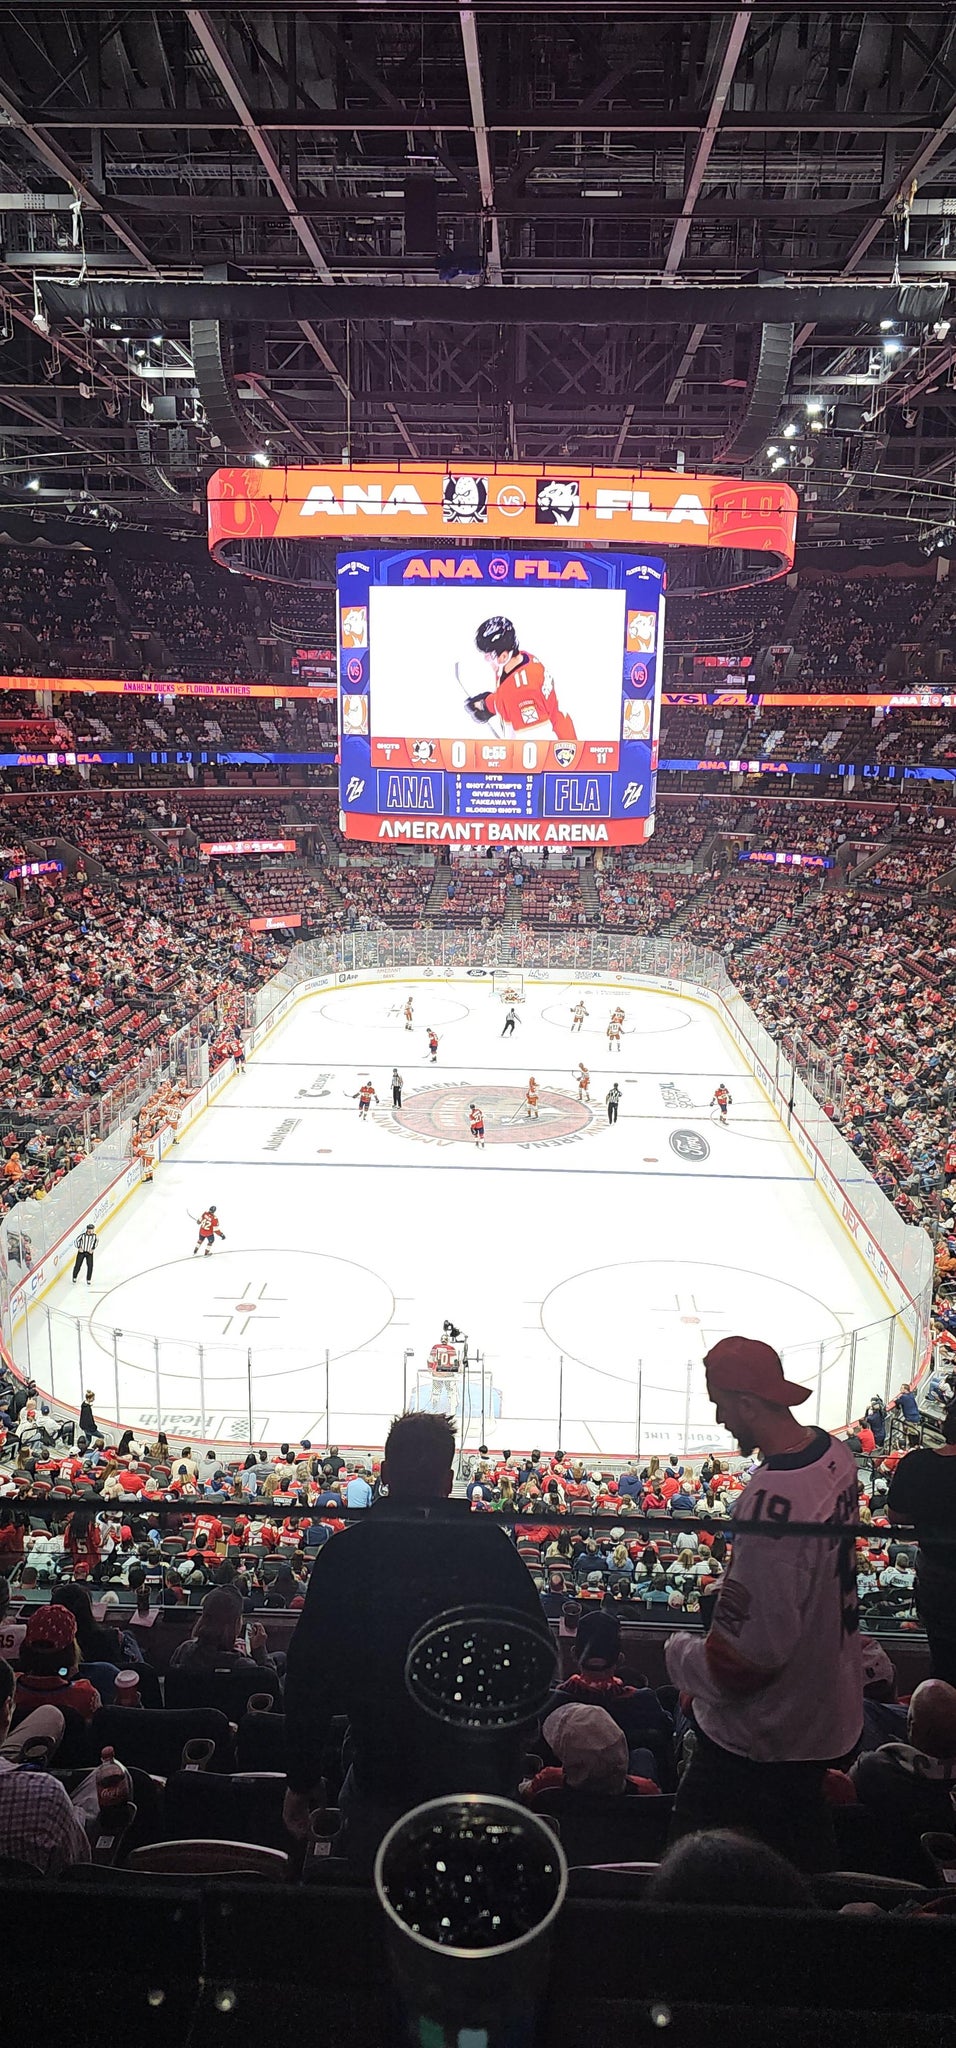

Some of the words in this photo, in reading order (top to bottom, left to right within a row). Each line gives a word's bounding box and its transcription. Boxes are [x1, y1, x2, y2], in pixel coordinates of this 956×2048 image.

[299, 484, 428, 515] ANA
[503, 495, 520, 504] VS
[596, 489, 709, 525] FLA
[402, 558, 483, 578] ANA
[514, 560, 589, 580] FLA
[350, 665, 360, 676] VS
[635, 670, 645, 681] VS
[514, 669, 528, 688] 11
[124, 683, 152, 691] ANAHEIM
[154, 683, 175, 692] DUCKS
[186, 685, 214, 694] FLORIDA
[216, 687, 251, 695] PANTHERS
[666, 695, 699, 703] VS
[17, 754, 46, 764] ANA
[76, 753, 102, 763] FLA
[452, 740, 466, 768] 0
[523, 741, 537, 769] 0
[597, 753, 607, 764] 11
[697, 761, 727, 770] ANA
[761, 762, 788, 772] FLA
[387, 775, 434, 809] ANA
[555, 778, 600, 811] FLA
[378, 820, 484, 841] AMERANT
[488, 823, 540, 842] BANK
[544, 823, 609, 842] ARENA
[139, 1414, 215, 1427] Health
[750, 1488, 791, 1530] 19
